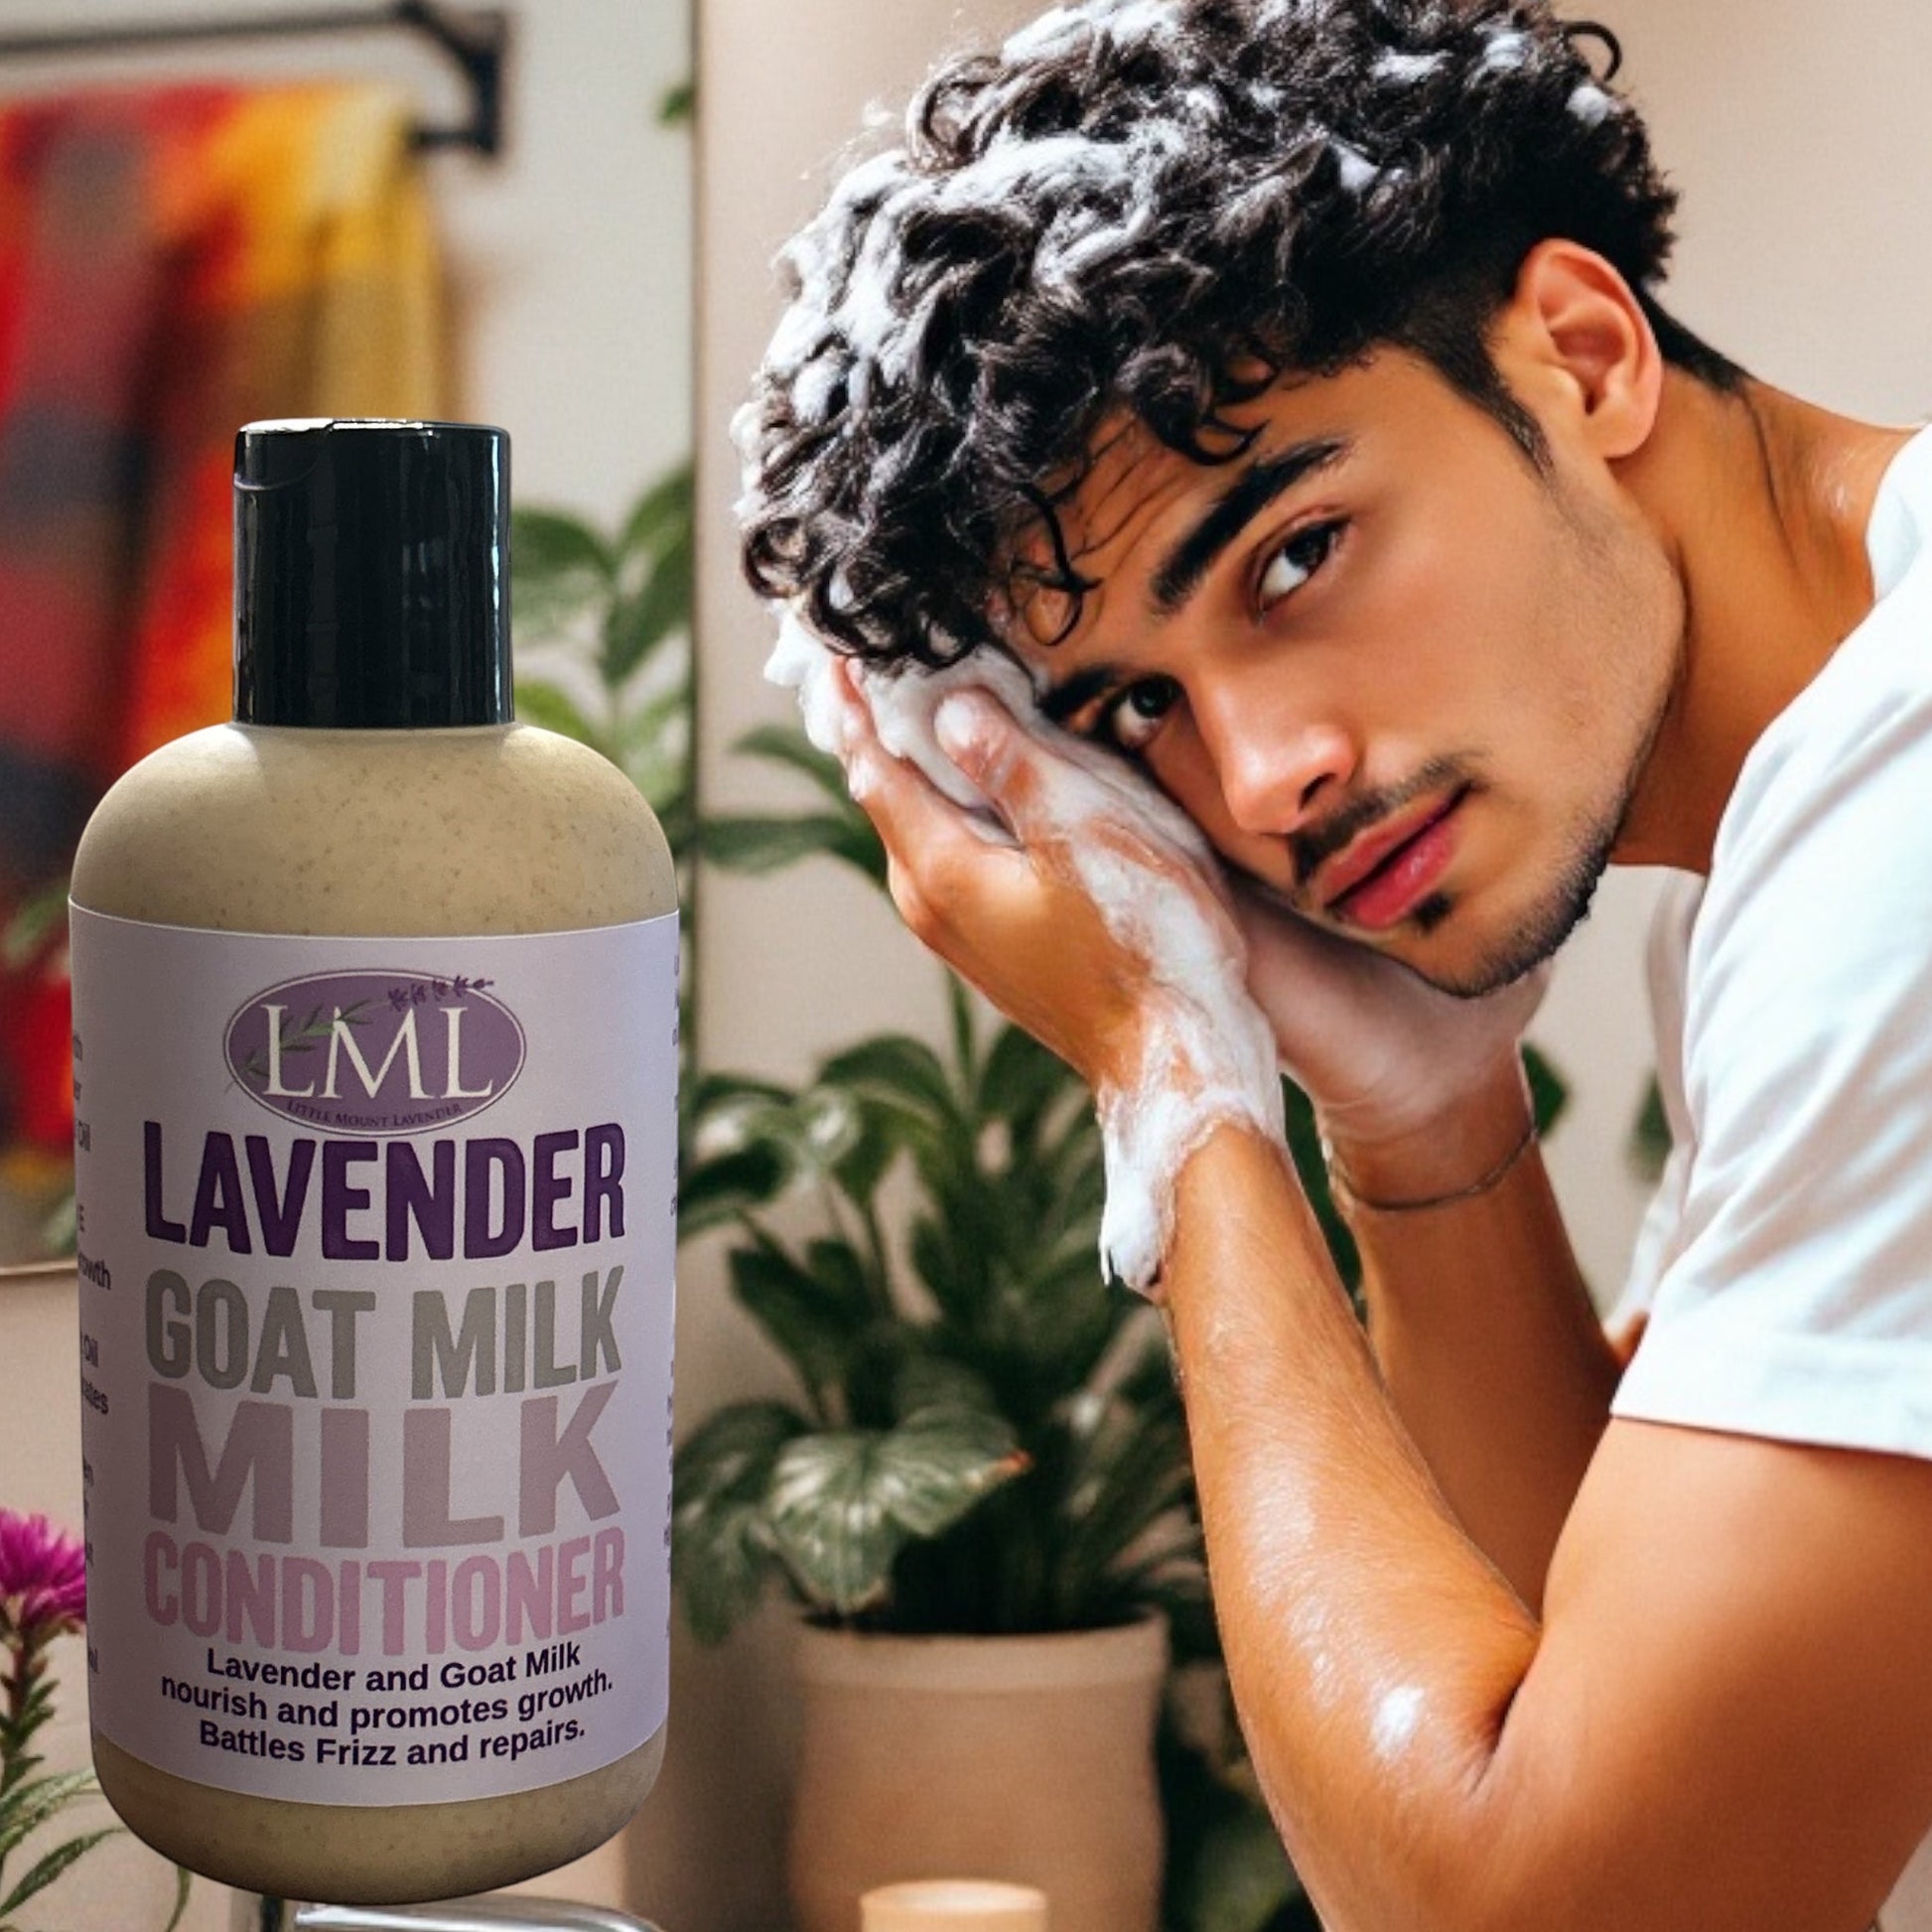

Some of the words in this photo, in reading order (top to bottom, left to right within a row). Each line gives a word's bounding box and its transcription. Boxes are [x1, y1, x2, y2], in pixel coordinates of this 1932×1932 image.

[260, 1004, 493, 1100] LML
[286, 1098, 331, 1125] LITTLE
[334, 1111, 388, 1129] MOUNT
[392, 1102, 463, 1128] LAVENDER
[143, 1120, 626, 1262] LAVENDER
[144, 1268, 376, 1400] GOAT
[411, 1264, 624, 1400] MILK
[147, 1380, 621, 1549] MILK
[143, 1526, 625, 1656] CONDITIONER
[161, 1675, 267, 1722] nourish
[277, 1699, 339, 1727] and
[350, 1698, 508, 1735] promotes
[517, 1667, 614, 1724] growth.
[206, 1646, 356, 1692] Lavender
[365, 1663, 429, 1692] and
[440, 1656, 517, 1690] Goat
[525, 1641, 582, 1678] Milk
[199, 1719, 306, 1762] Battles
[316, 1736, 397, 1766] Frizz
[407, 1735, 469, 1765] and
[479, 1718, 586, 1760] repairs.
